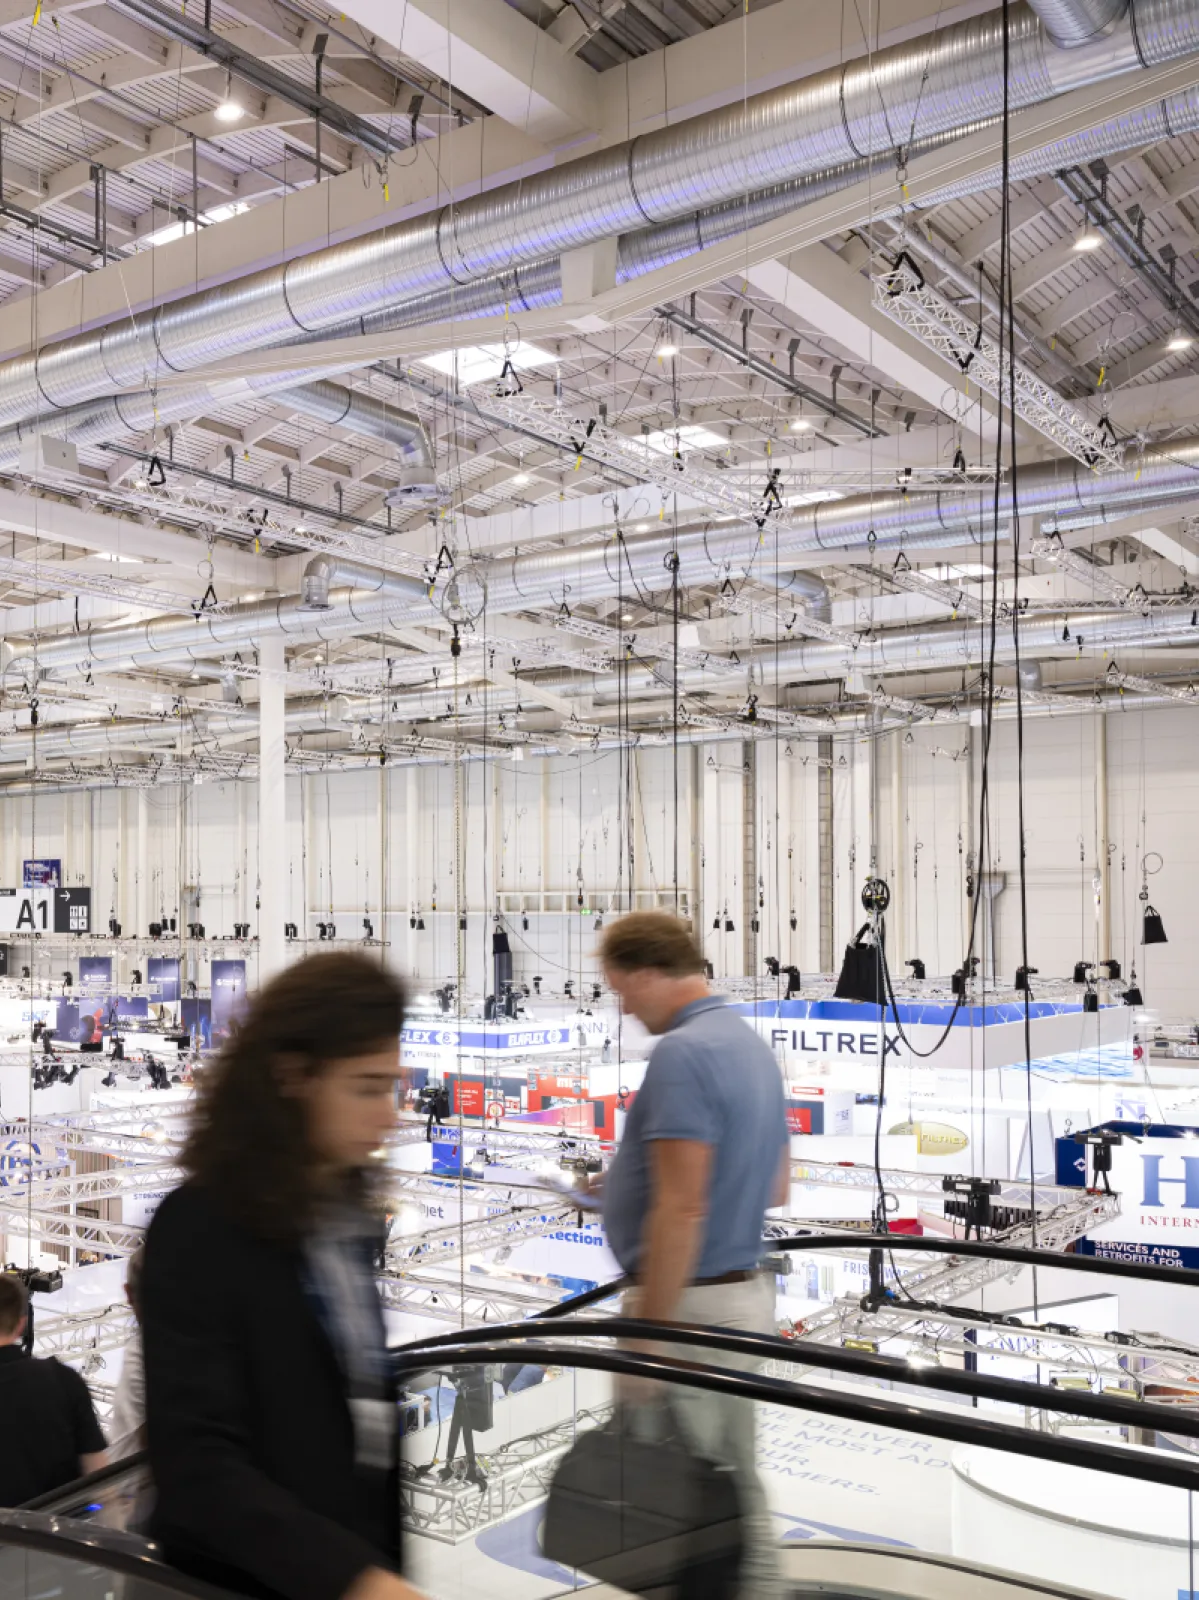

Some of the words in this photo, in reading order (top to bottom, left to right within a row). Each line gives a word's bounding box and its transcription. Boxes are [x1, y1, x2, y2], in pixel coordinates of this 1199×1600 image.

[16, 899, 48, 929] A1
[400, 1029, 431, 1043] FLEX
[771, 1029, 902, 1057] FILTREX
[1095, 1240, 1149, 1255] SERVICES
[1152, 1247, 1180, 1259] AND
[1095, 1249, 1155, 1265] RETROFITS
[1159, 1257, 1184, 1268] FOR
[794, 1430, 892, 1456] MOST
[802, 1418, 933, 1453] DELIVER
